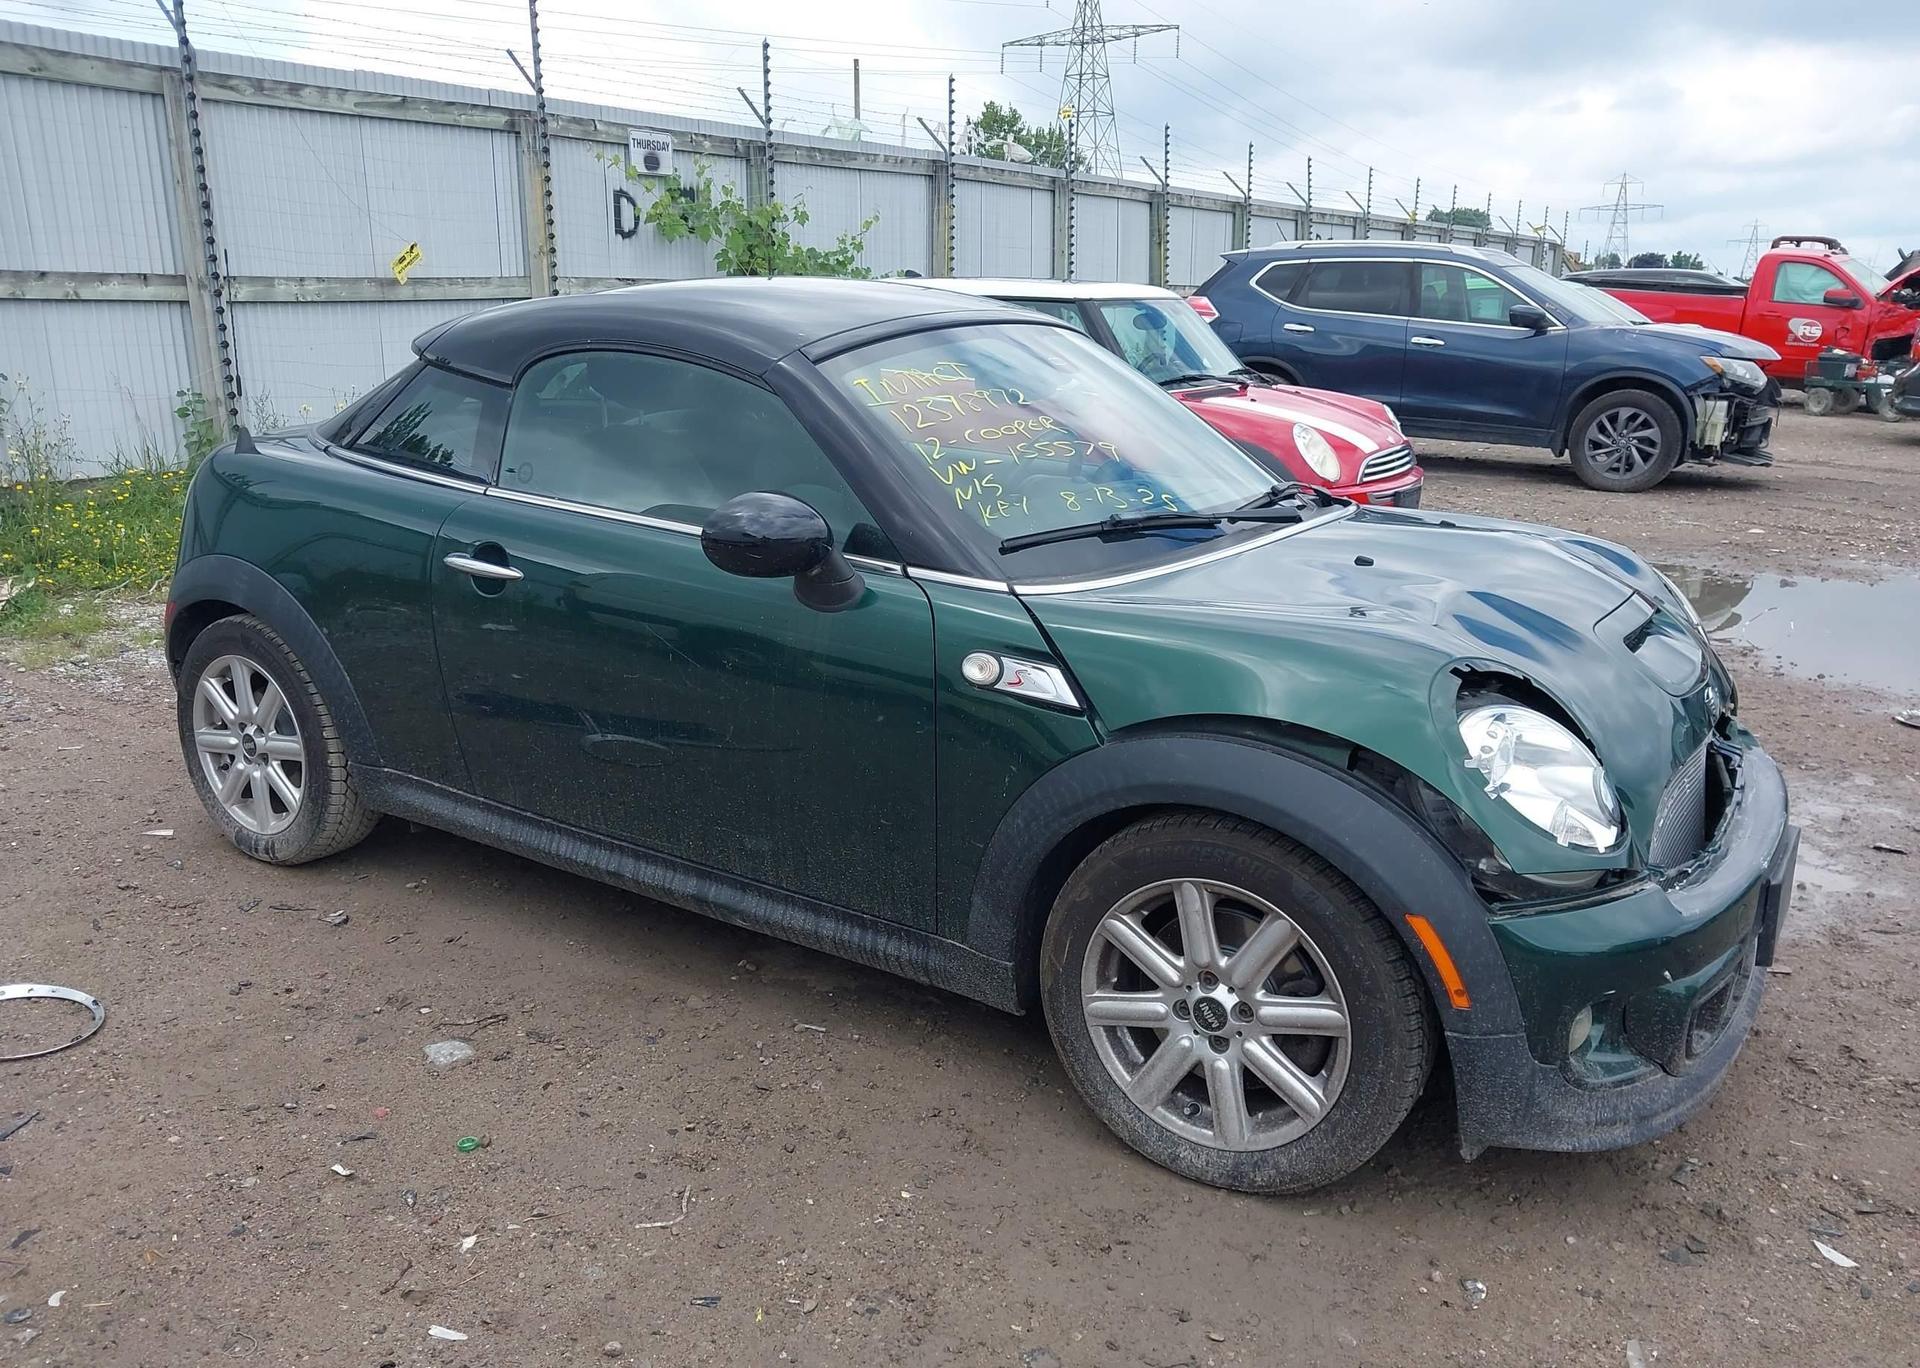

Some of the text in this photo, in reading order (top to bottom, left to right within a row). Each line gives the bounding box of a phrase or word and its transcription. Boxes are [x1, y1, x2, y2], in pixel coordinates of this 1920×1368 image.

[631, 137, 670, 153] THURSDAY
[1798, 325, 1821, 337] RS
[1199, 1002, 1220, 1028] MINI
